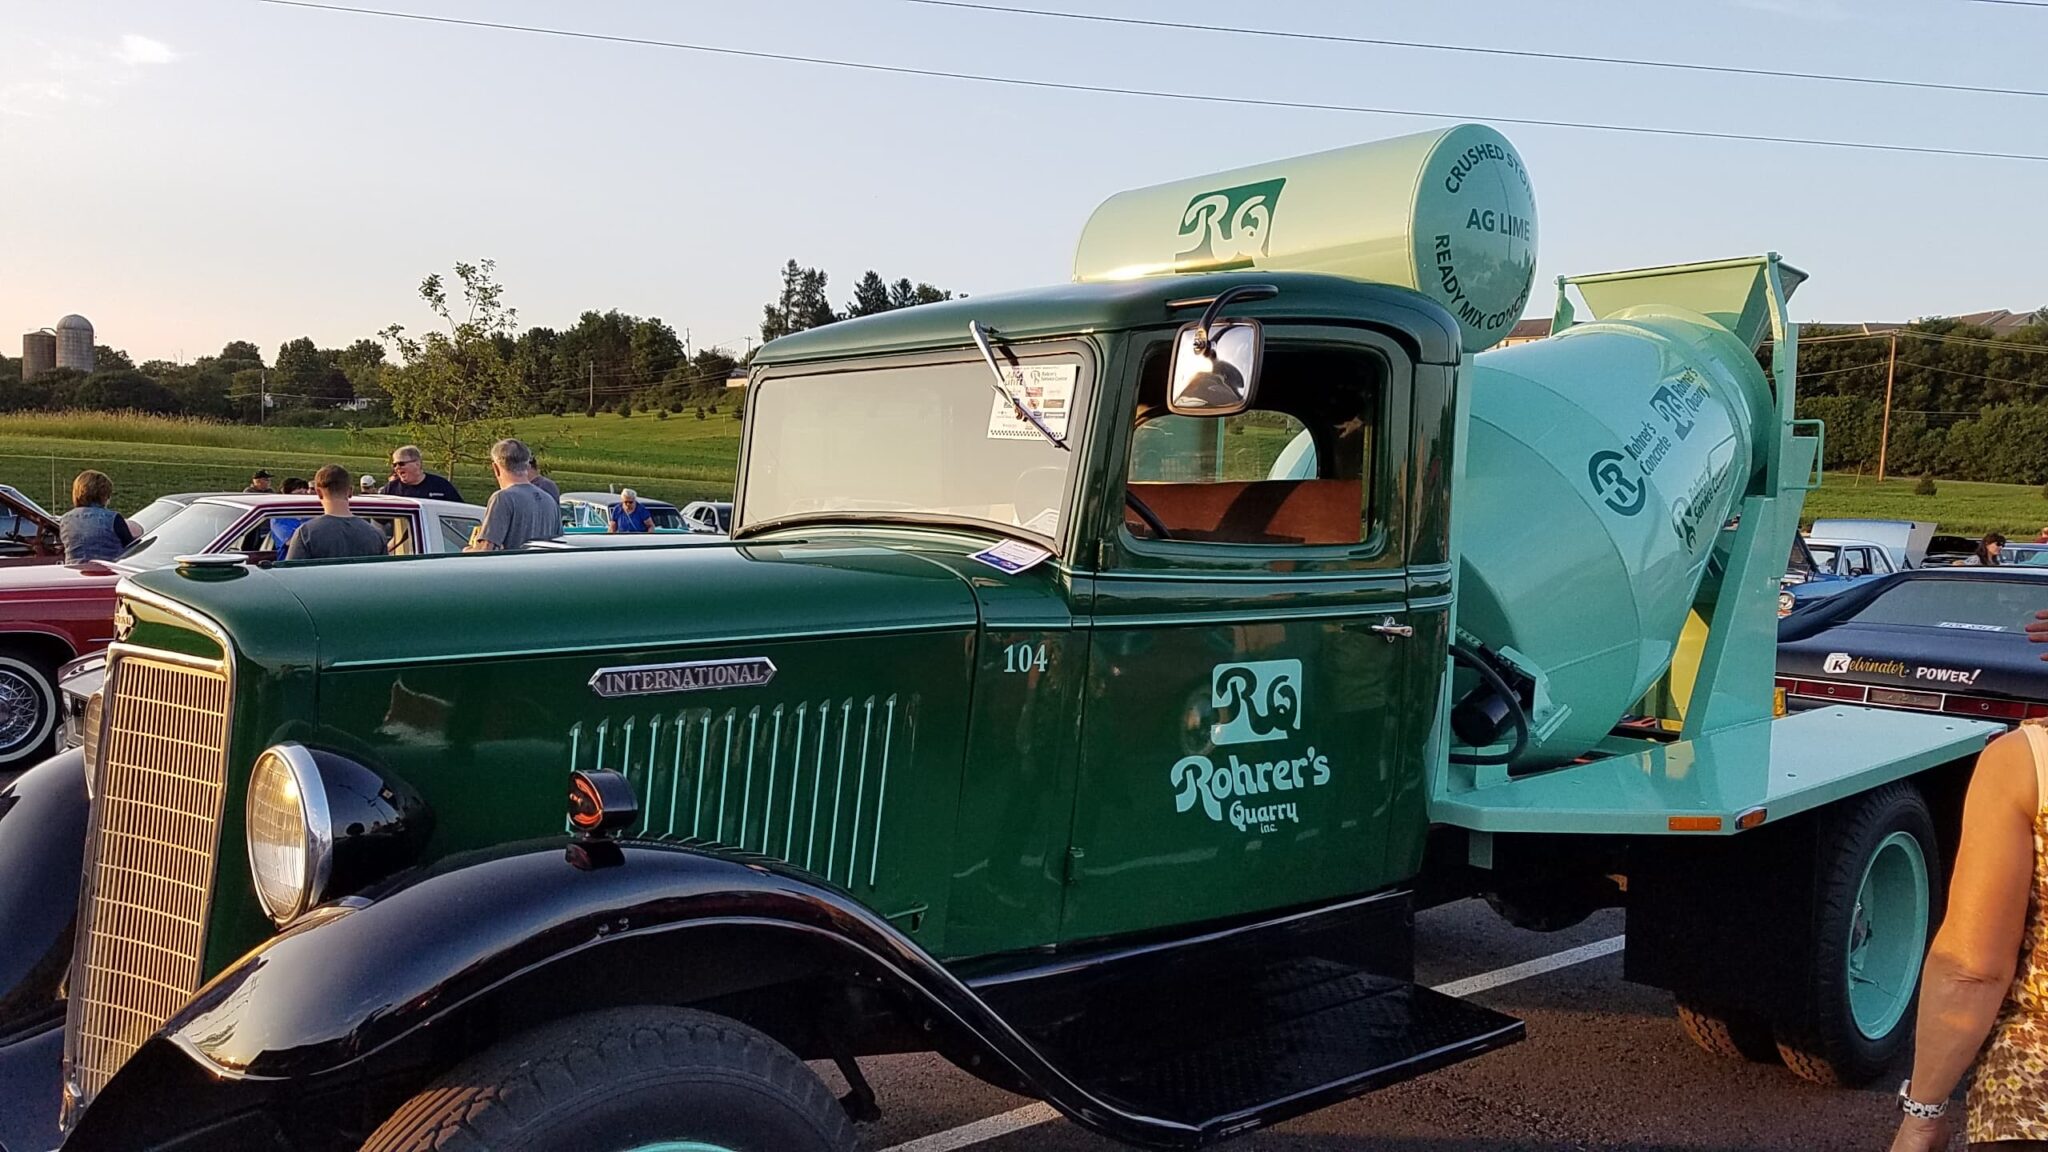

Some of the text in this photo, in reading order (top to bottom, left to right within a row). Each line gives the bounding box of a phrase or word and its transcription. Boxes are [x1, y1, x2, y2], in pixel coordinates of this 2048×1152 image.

[1445, 143, 1504, 194] CRUSHED
[1466, 208, 1531, 242] AG LIME
[1435, 234, 1537, 330] READY MIX CONCR
[1624, 420, 1656, 461] Rohrer's
[1640, 436, 1672, 476] Concrete
[1003, 643, 1048, 673] 104
[1831, 655, 1982, 685] Kelvinator POWER!
[604, 663, 765, 694] INTERNATIONAL
[1170, 746, 1331, 822] Rohrer's
[1229, 800, 1299, 832] Quarry
